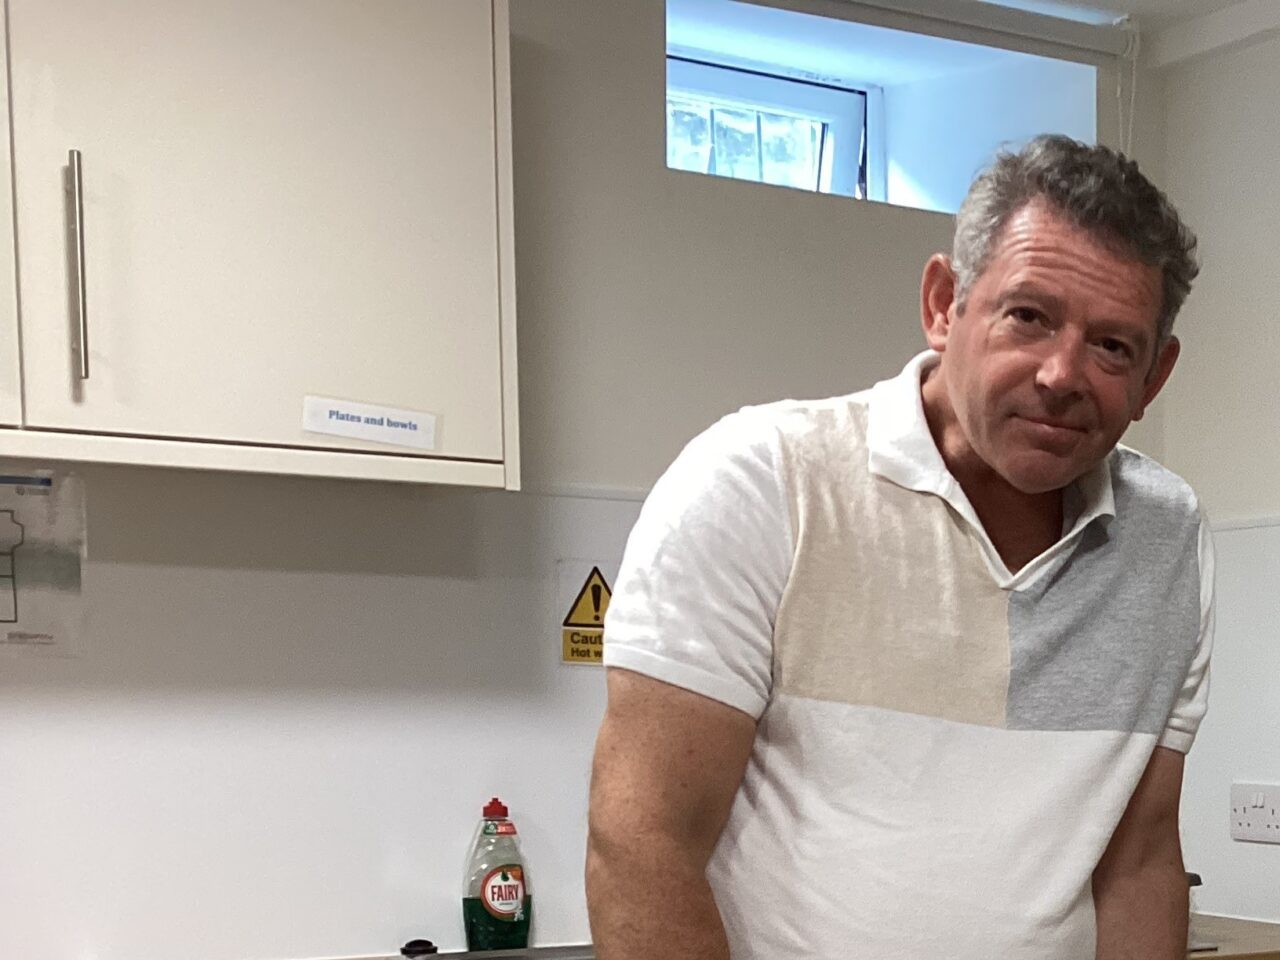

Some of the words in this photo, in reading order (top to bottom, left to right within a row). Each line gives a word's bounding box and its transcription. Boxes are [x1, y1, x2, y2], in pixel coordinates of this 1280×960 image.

[328, 410, 362, 423] Plates
[364, 415, 384, 426] and
[386, 418, 418, 431] bowls
[570, 647, 591, 657] Hot
[490, 884, 519, 902] FAIRY
